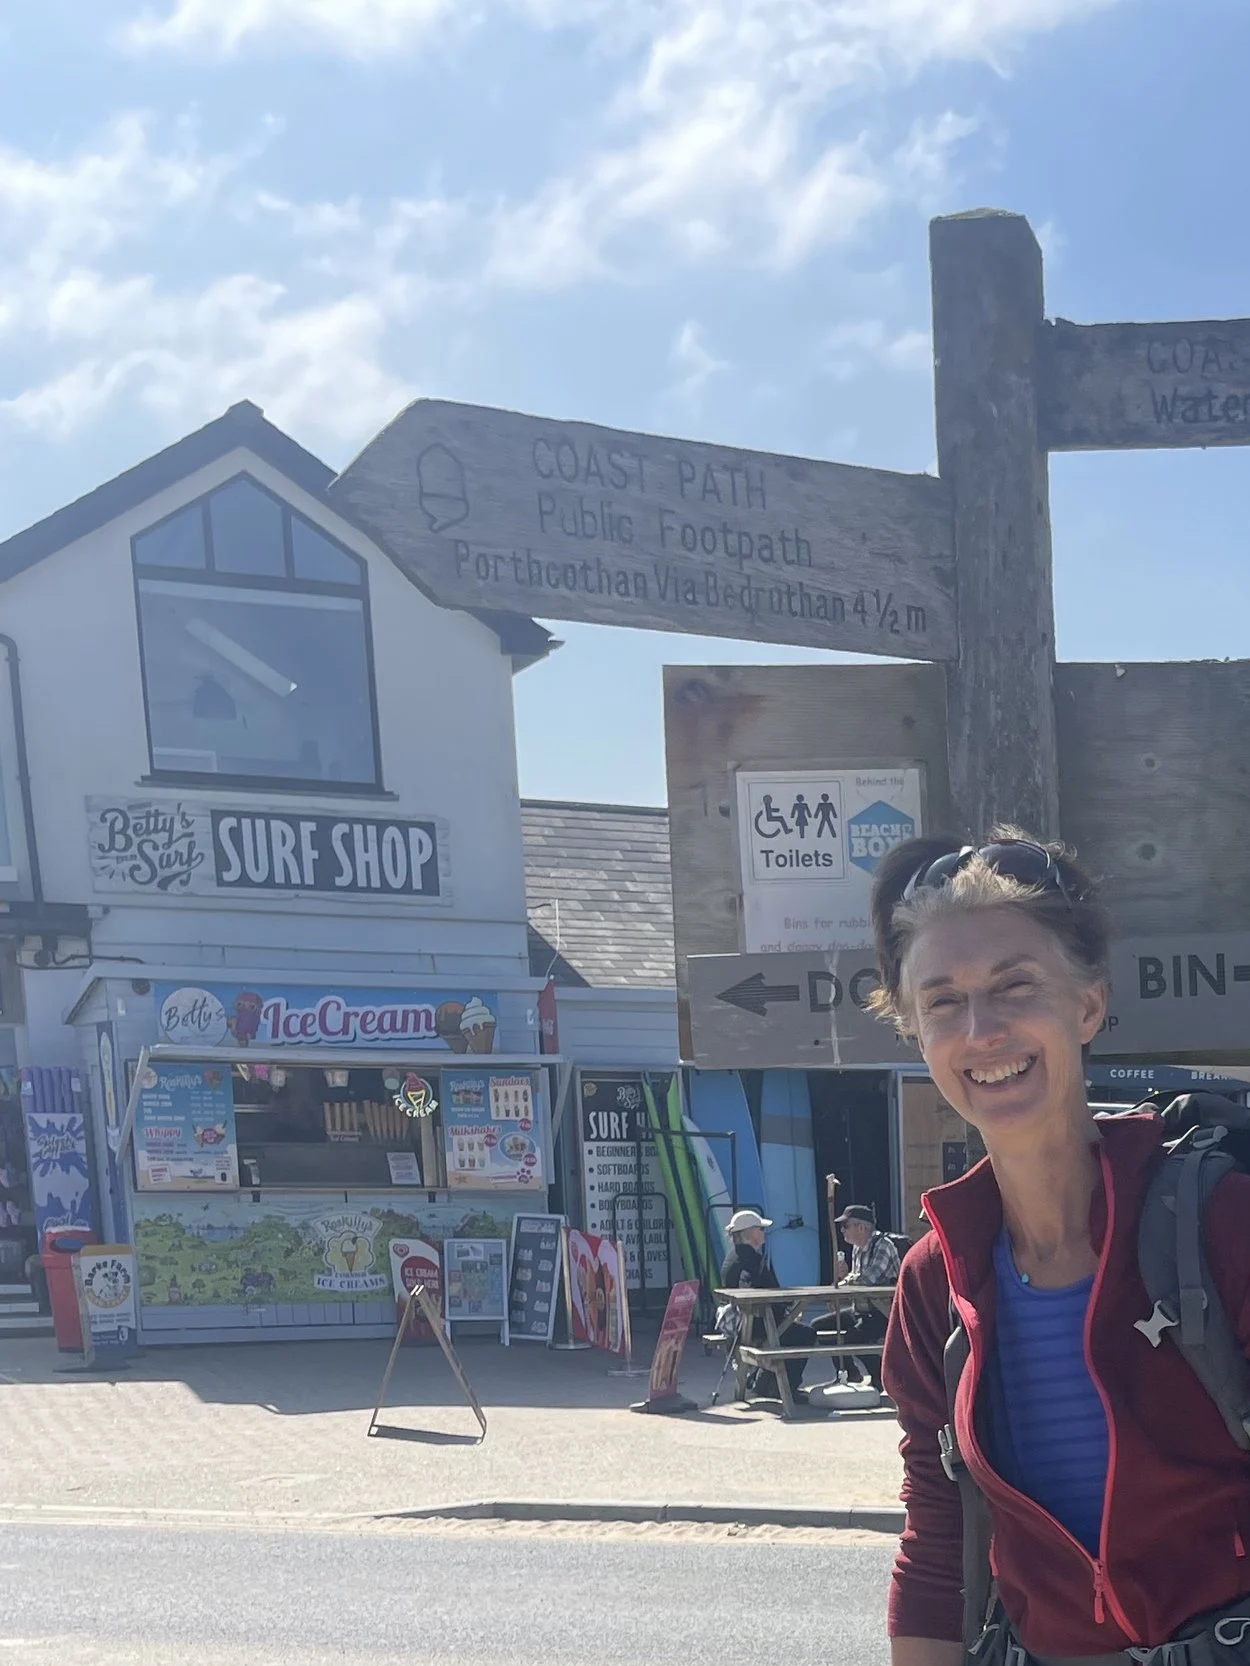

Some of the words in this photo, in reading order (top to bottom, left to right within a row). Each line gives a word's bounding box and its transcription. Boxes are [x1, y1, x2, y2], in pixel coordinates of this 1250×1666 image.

[532, 436, 648, 493] COAST
[677, 459, 767, 510] PATH
[537, 490, 634, 544] Public
[659, 508, 812, 570] Footpath
[453, 540, 648, 600] Porthcothan
[654, 564, 698, 607] Via
[704, 571, 846, 625] Bedruthan
[855, 776, 887, 787] Behind
[97, 802, 195, 853] Betty's
[129, 838, 205, 888] Surf
[218, 816, 319, 885] SURF
[331, 822, 433, 890] SHOP
[760, 849, 834, 869] Toilets
[784, 917, 808, 930] Bins
[814, 917, 833, 930] for
[807, 967, 884, 1013] DO
[1138, 953, 1227, 1000] BIN
[1109, 1069, 1154, 1079] COFFEE
[392, 1095, 406, 1111] ICE
[406, 1099, 439, 1118] CREAM
[588, 1111, 628, 1139] SURF
[598, 1181, 620, 1193] HARD
[622, 1181, 655, 1193] BOADS
[598, 1199, 653, 1211] BODYBOADS
[317, 1277, 333, 1288] ICE
[340, 1277, 385, 1289] CREAMS
